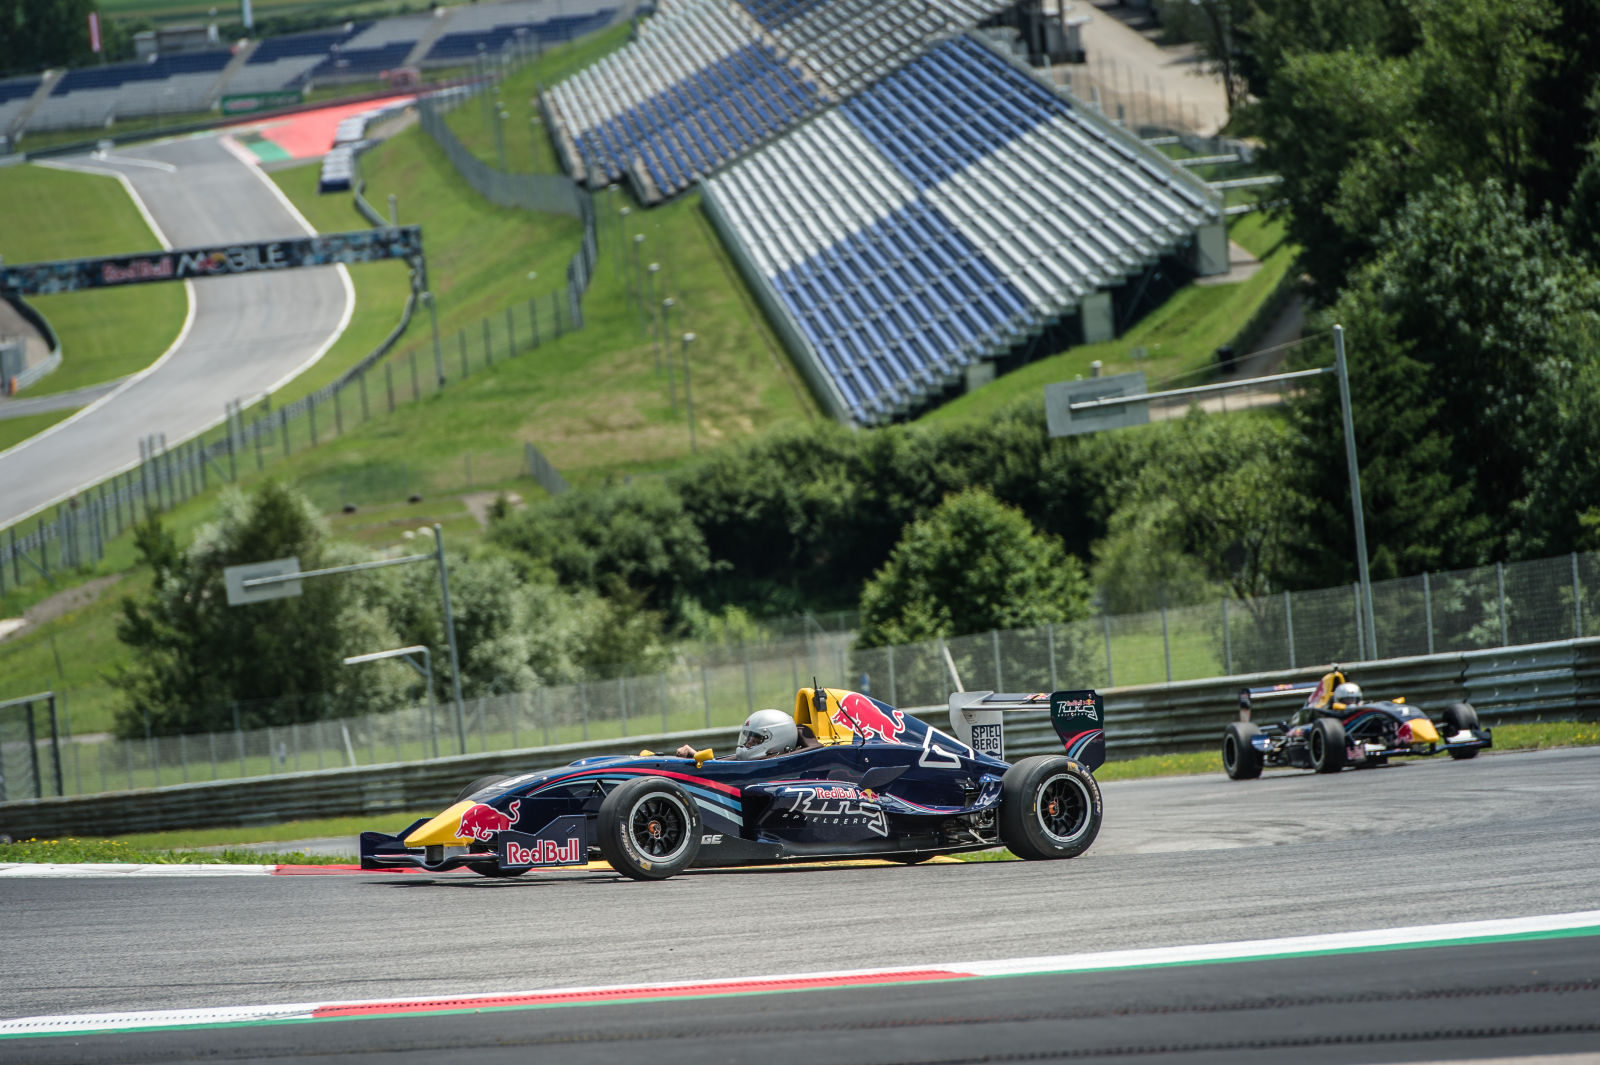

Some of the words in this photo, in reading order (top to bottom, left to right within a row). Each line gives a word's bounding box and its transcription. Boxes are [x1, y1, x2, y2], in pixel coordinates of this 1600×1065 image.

[973, 726, 1000, 738] SPIEL
[973, 738, 998, 750] BERG
[816, 787, 838, 799] Red
[839, 787, 858, 800] Bull
[701, 834, 723, 845] GE
[507, 839, 543, 864] Red
[544, 838, 579, 863] Bull
